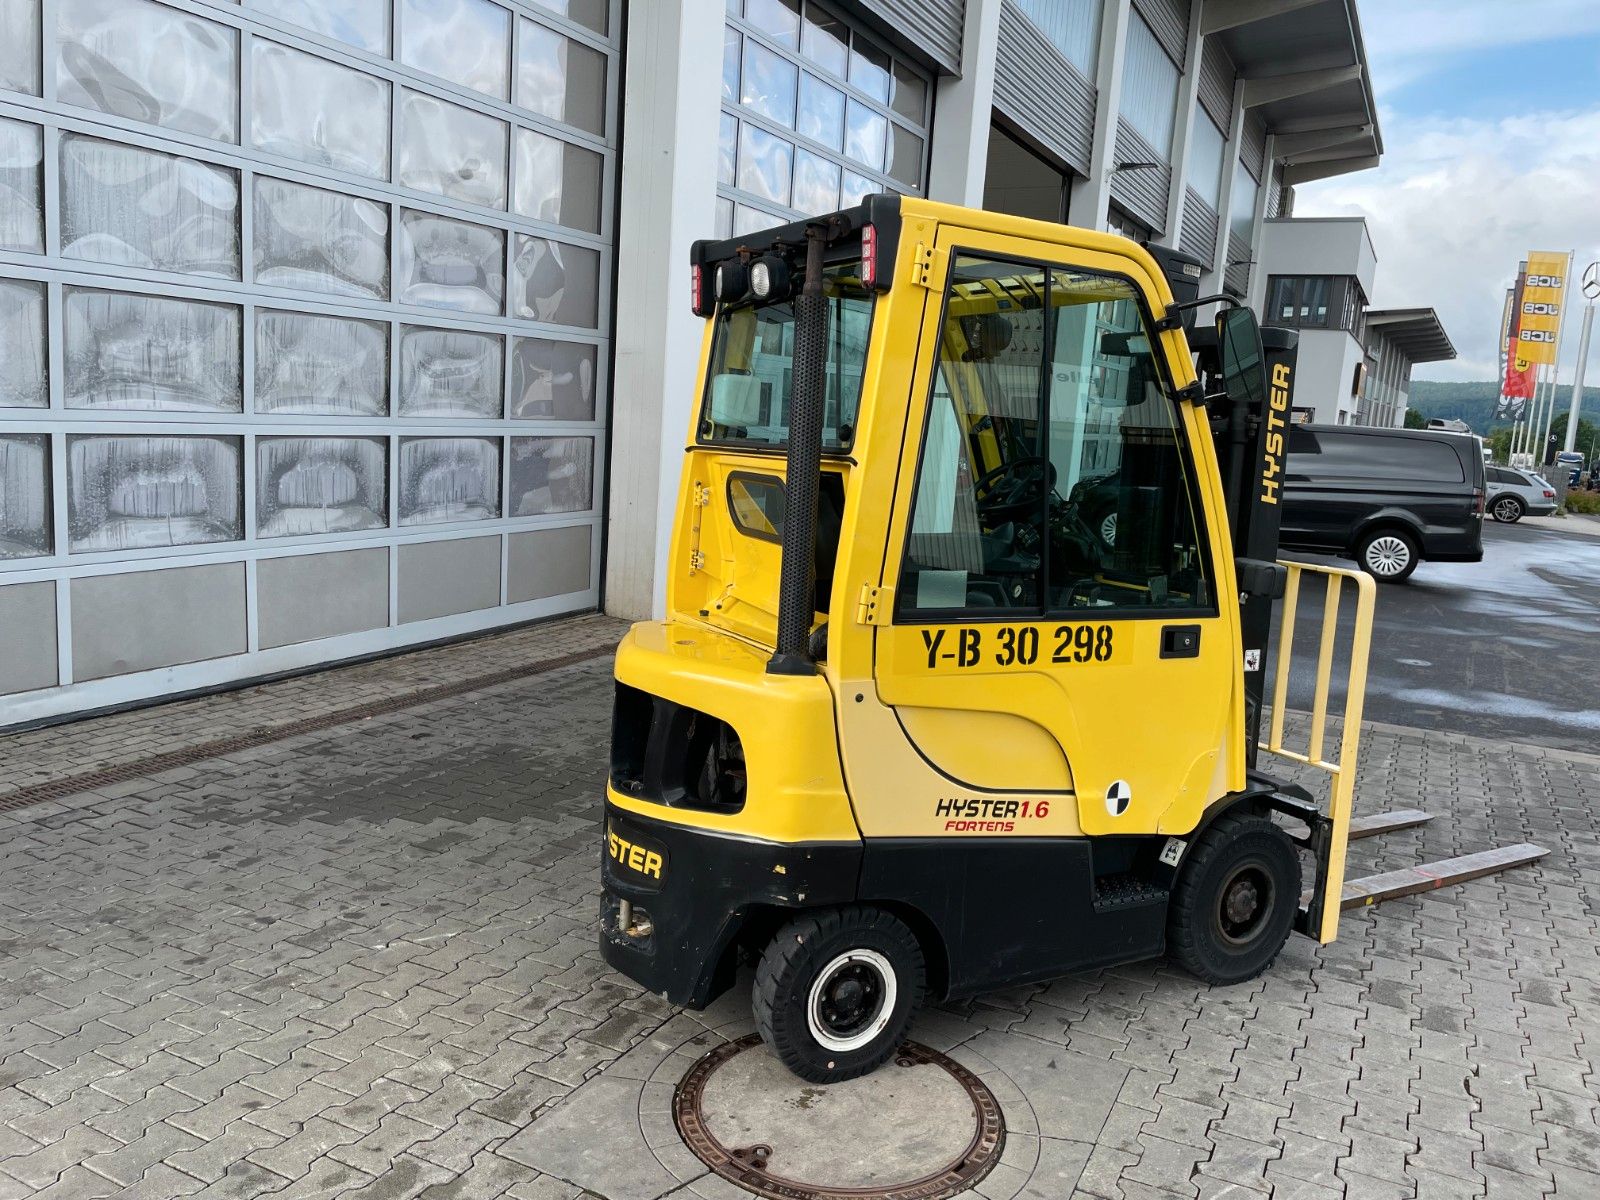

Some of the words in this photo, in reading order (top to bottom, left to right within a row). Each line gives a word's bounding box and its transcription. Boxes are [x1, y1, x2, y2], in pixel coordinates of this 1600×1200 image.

[1260, 363, 1291, 505] HYSTER
[921, 628, 982, 669] Y-B
[995, 626, 1040, 666] 30
[1051, 624, 1114, 664] 298
[935, 798, 1020, 818] HYSTER
[1020, 800, 1050, 819] 1.6
[944, 820, 1015, 832] FORTENS
